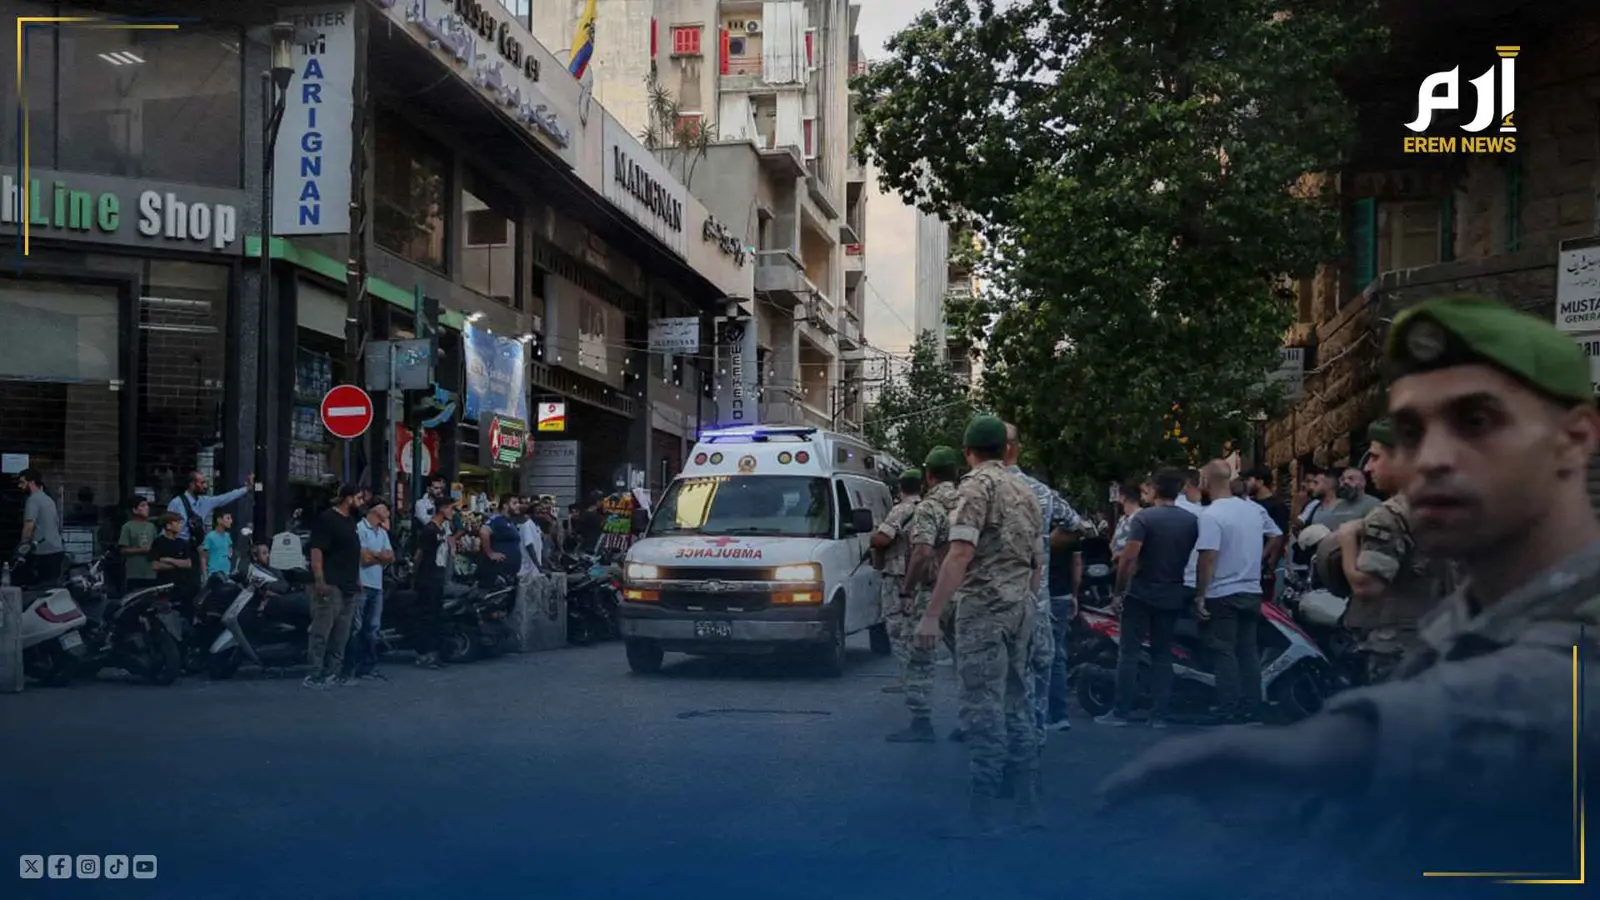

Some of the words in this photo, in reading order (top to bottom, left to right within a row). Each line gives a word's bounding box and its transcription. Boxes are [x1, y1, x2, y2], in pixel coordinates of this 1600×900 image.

[283, 10, 346, 28] ENTER
[299, 34, 326, 226] MARIGNAN
[139, 190, 236, 249] Shop
[613, 145, 682, 233] MARIGNAN
